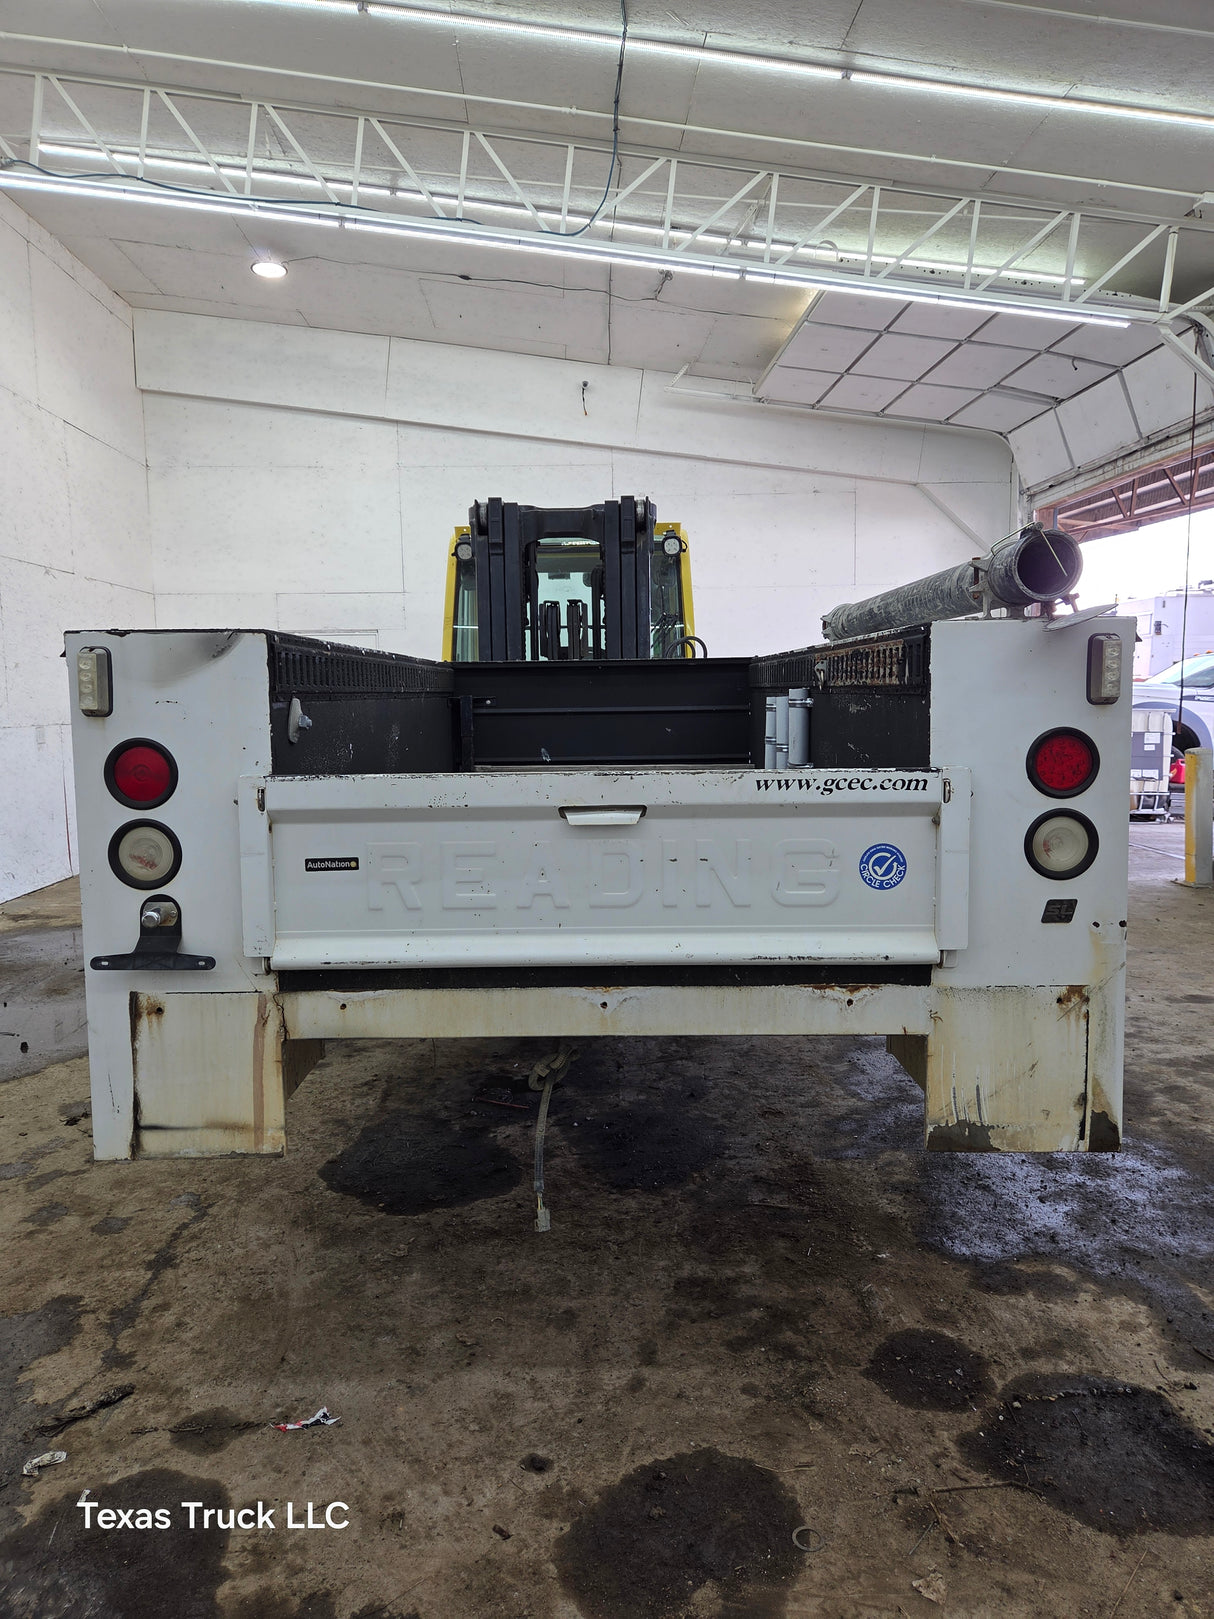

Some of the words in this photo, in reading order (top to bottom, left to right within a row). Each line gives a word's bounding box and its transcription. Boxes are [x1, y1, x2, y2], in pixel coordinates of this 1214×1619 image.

[755, 776, 929, 796] www.gcec.com
[306, 860, 351, 869] AutoNation
[365, 838, 841, 911] READING
[860, 863, 881, 888] CIRCLE
[882, 864, 906, 888] CHECK
